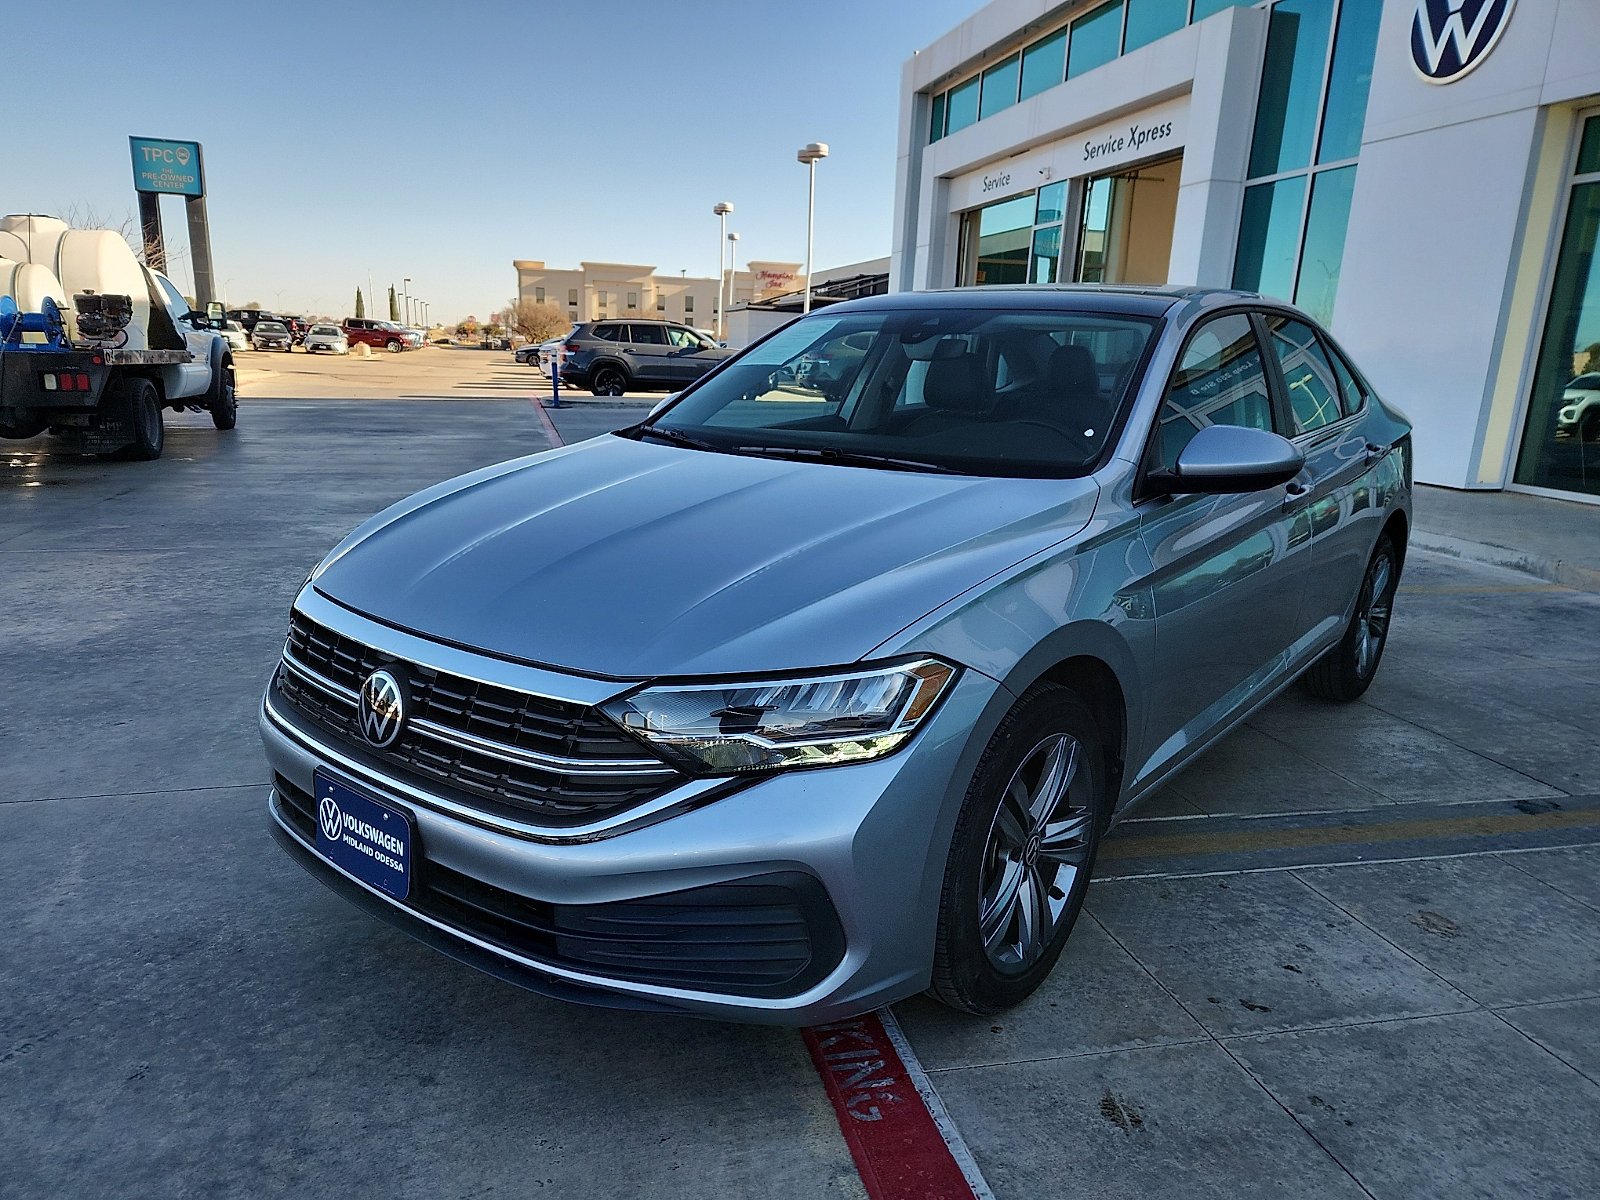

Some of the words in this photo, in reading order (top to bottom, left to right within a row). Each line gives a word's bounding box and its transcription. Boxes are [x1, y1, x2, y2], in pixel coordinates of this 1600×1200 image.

[141, 147, 173, 163] TPC
[1083, 135, 1124, 161] Service
[1127, 121, 1172, 150] Xpress
[142, 172, 193, 182] PRE-OWNED
[982, 170, 1011, 192] Service
[319, 797, 342, 841] VW
[342, 811, 404, 857] VOLKSWAGEN
[342, 833, 374, 857] MIDLAND
[374, 850, 404, 873] ODESSA
